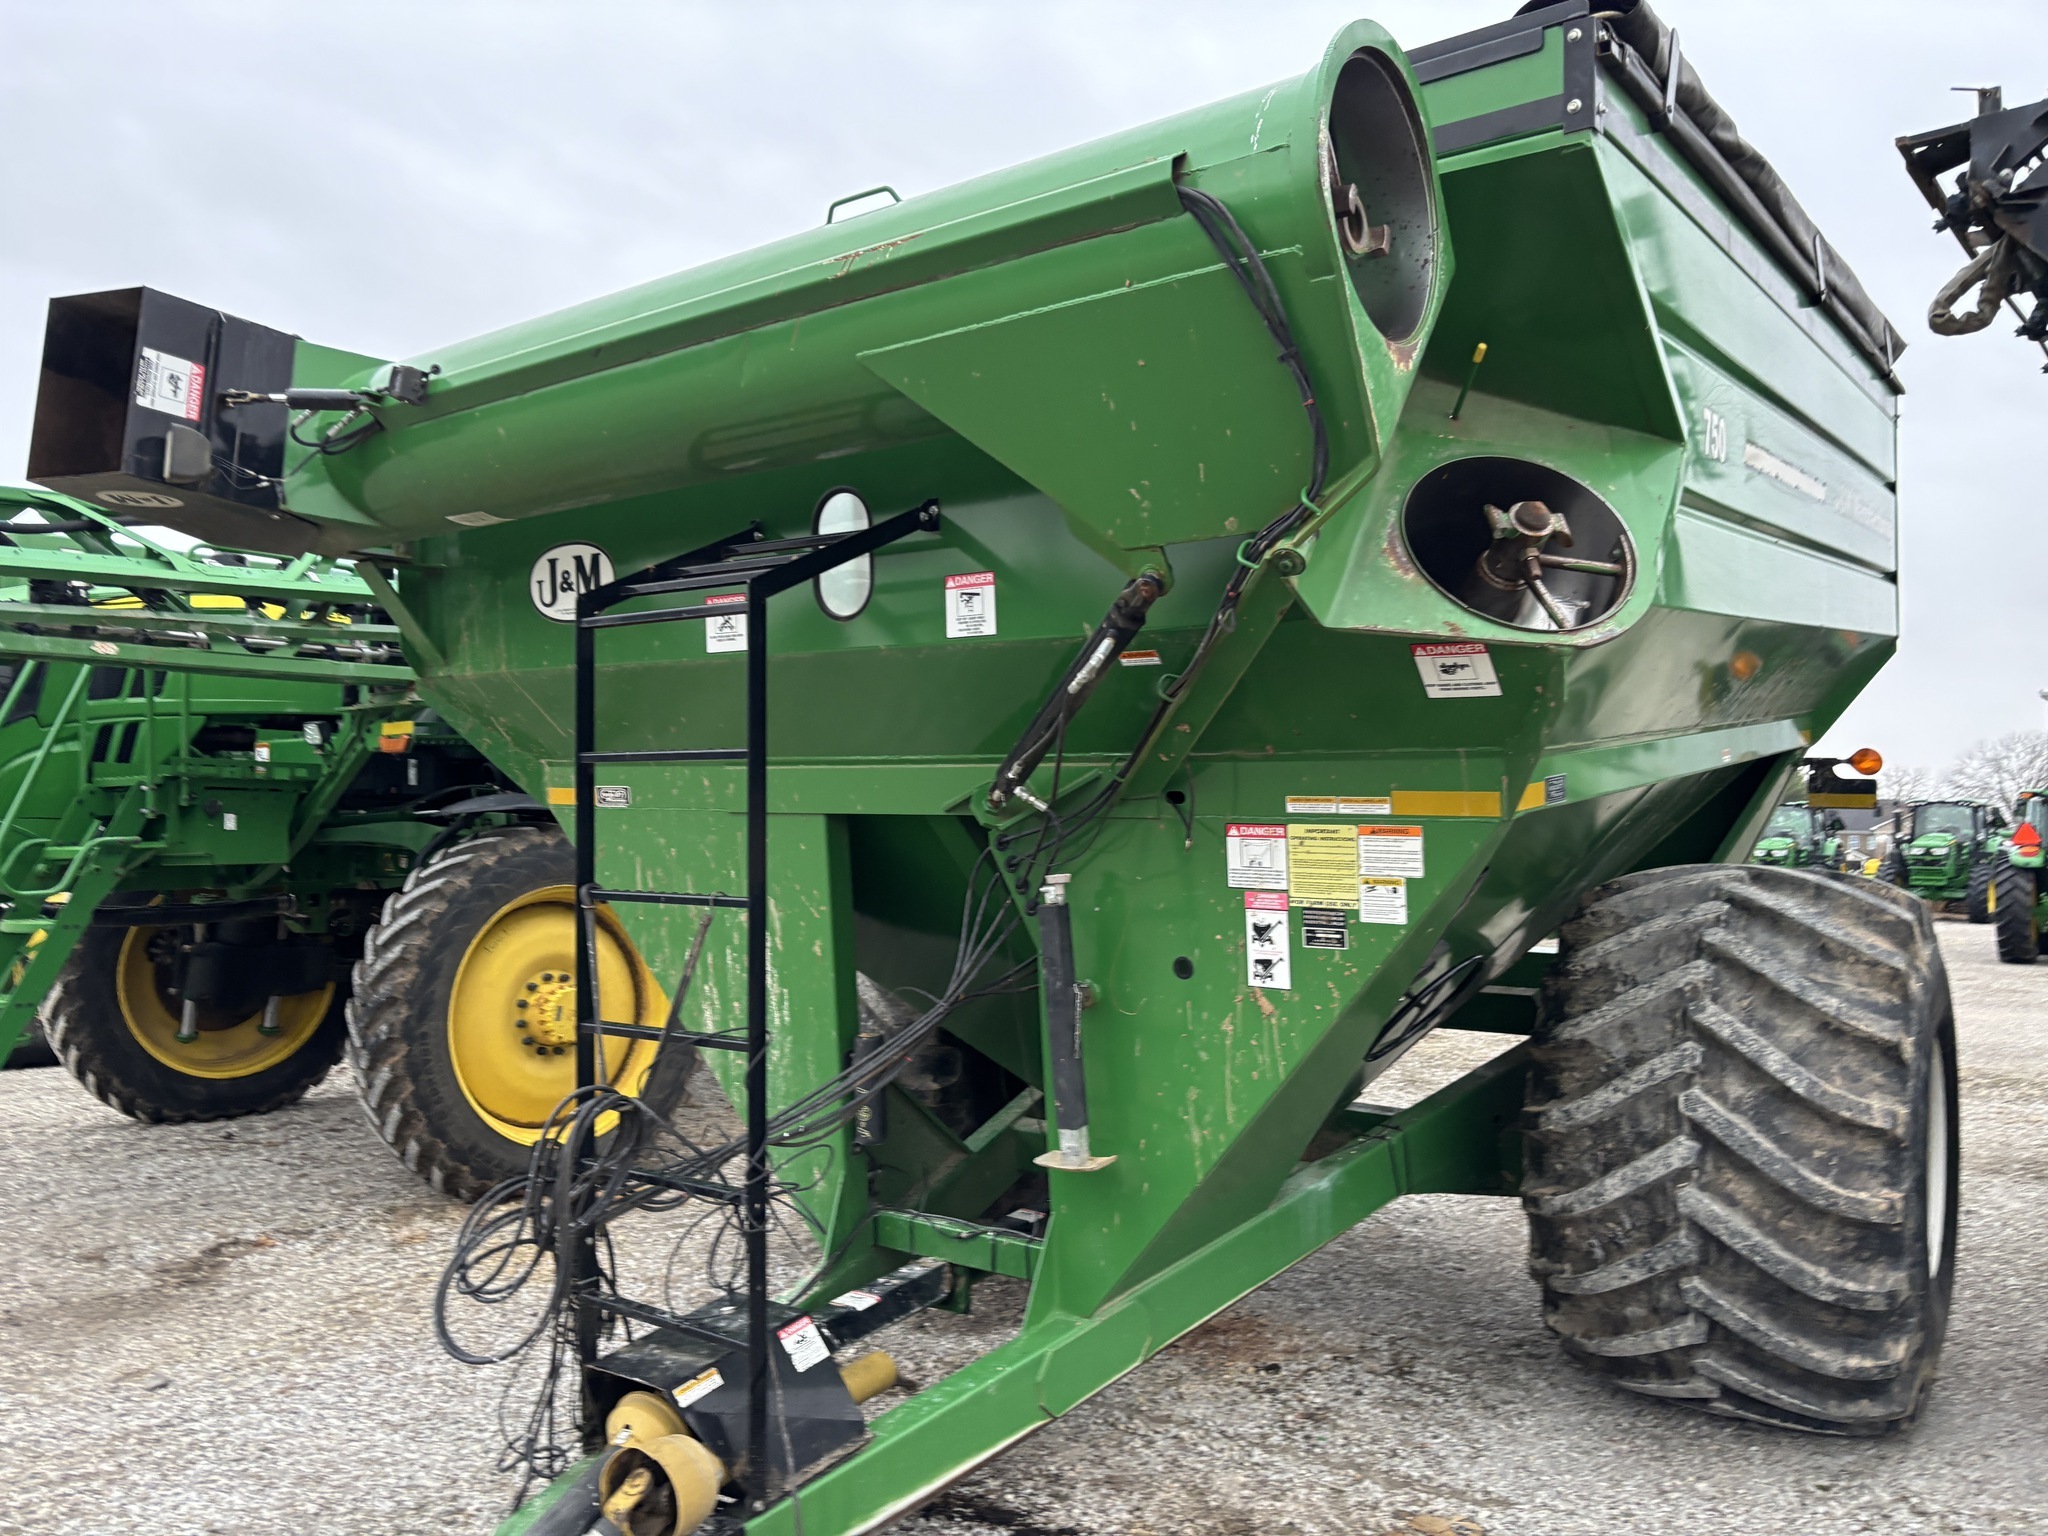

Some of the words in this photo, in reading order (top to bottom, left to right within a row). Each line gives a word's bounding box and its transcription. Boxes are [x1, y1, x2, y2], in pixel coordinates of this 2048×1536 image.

[187, 376, 204, 421] DANGER
[1703, 407, 1727, 464] 750
[536, 552, 602, 608] J&M
[955, 573, 994, 585] DANGER
[1427, 644, 1486, 655] DANGER
[1239, 827, 1285, 836] DANGER
